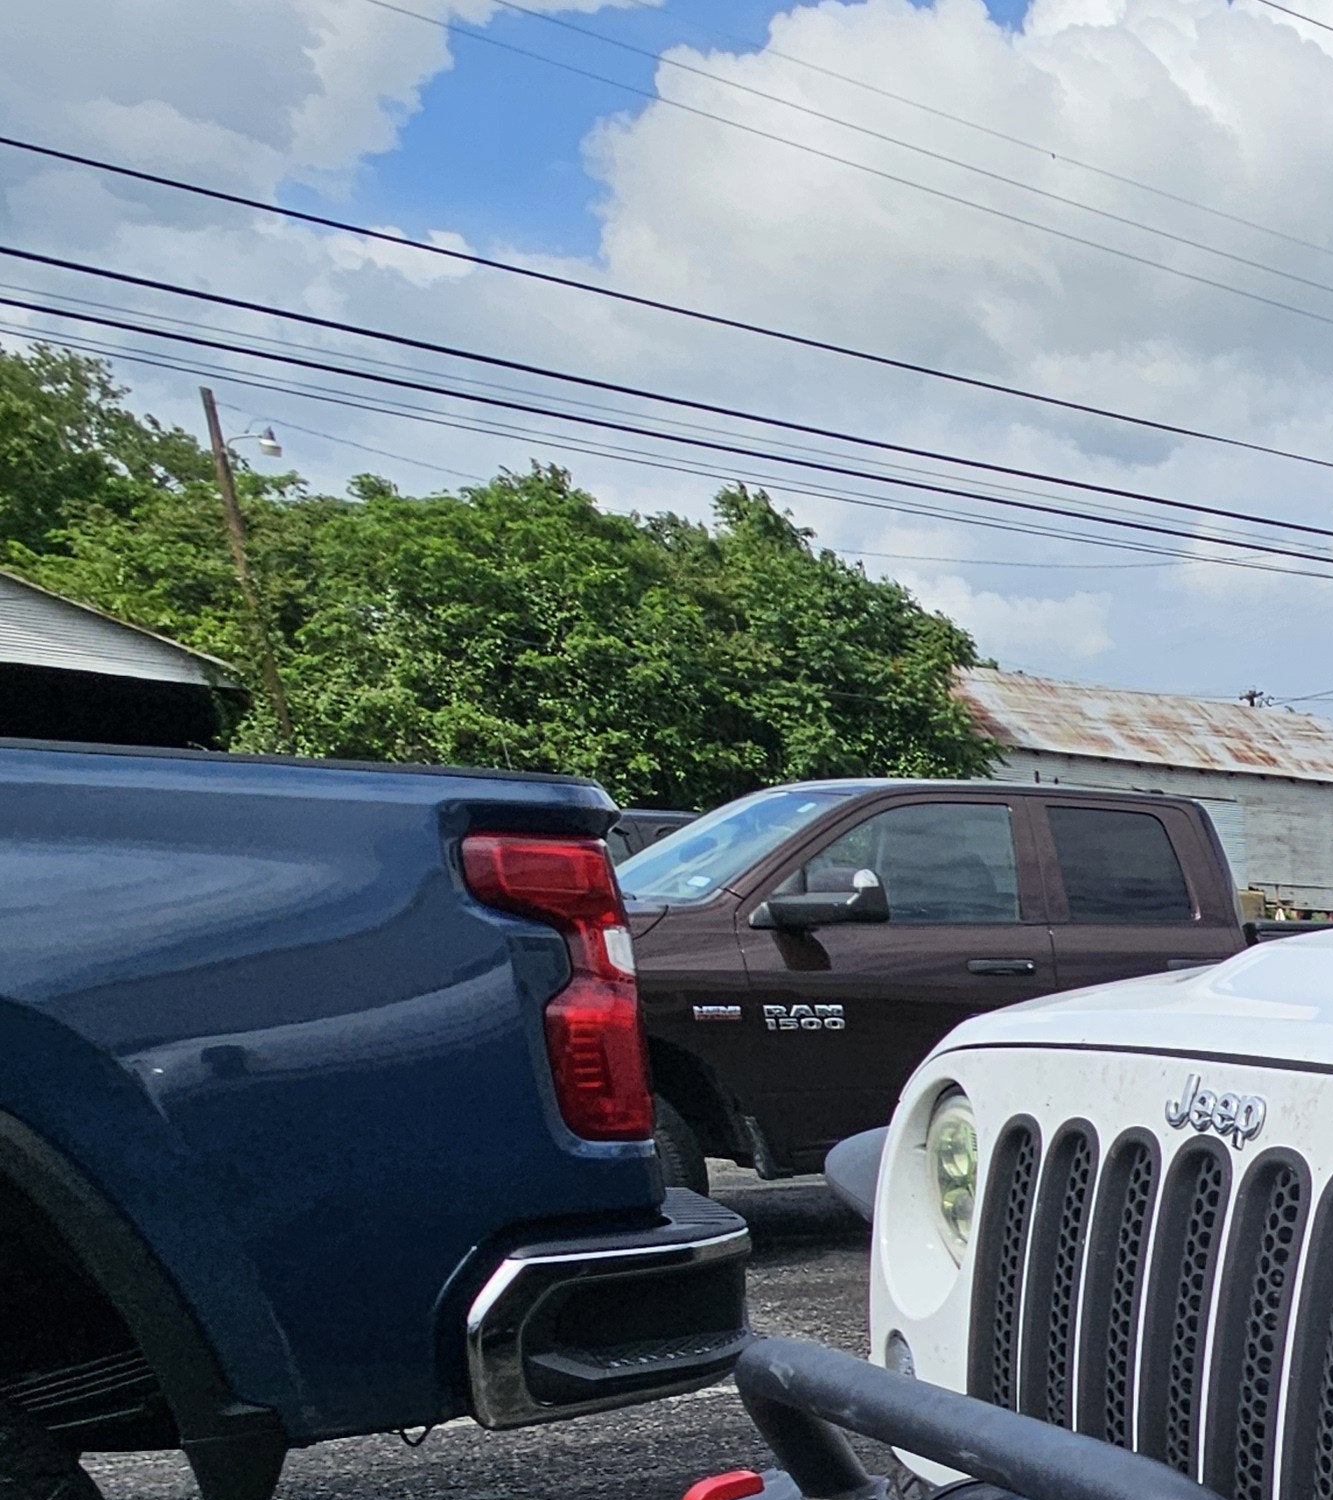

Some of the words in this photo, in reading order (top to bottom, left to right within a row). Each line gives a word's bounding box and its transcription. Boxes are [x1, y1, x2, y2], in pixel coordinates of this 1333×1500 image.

[763, 1004, 844, 1017] RAM
[765, 1018, 845, 1030] 1500
[1164, 1073, 1267, 1151] Jeep
